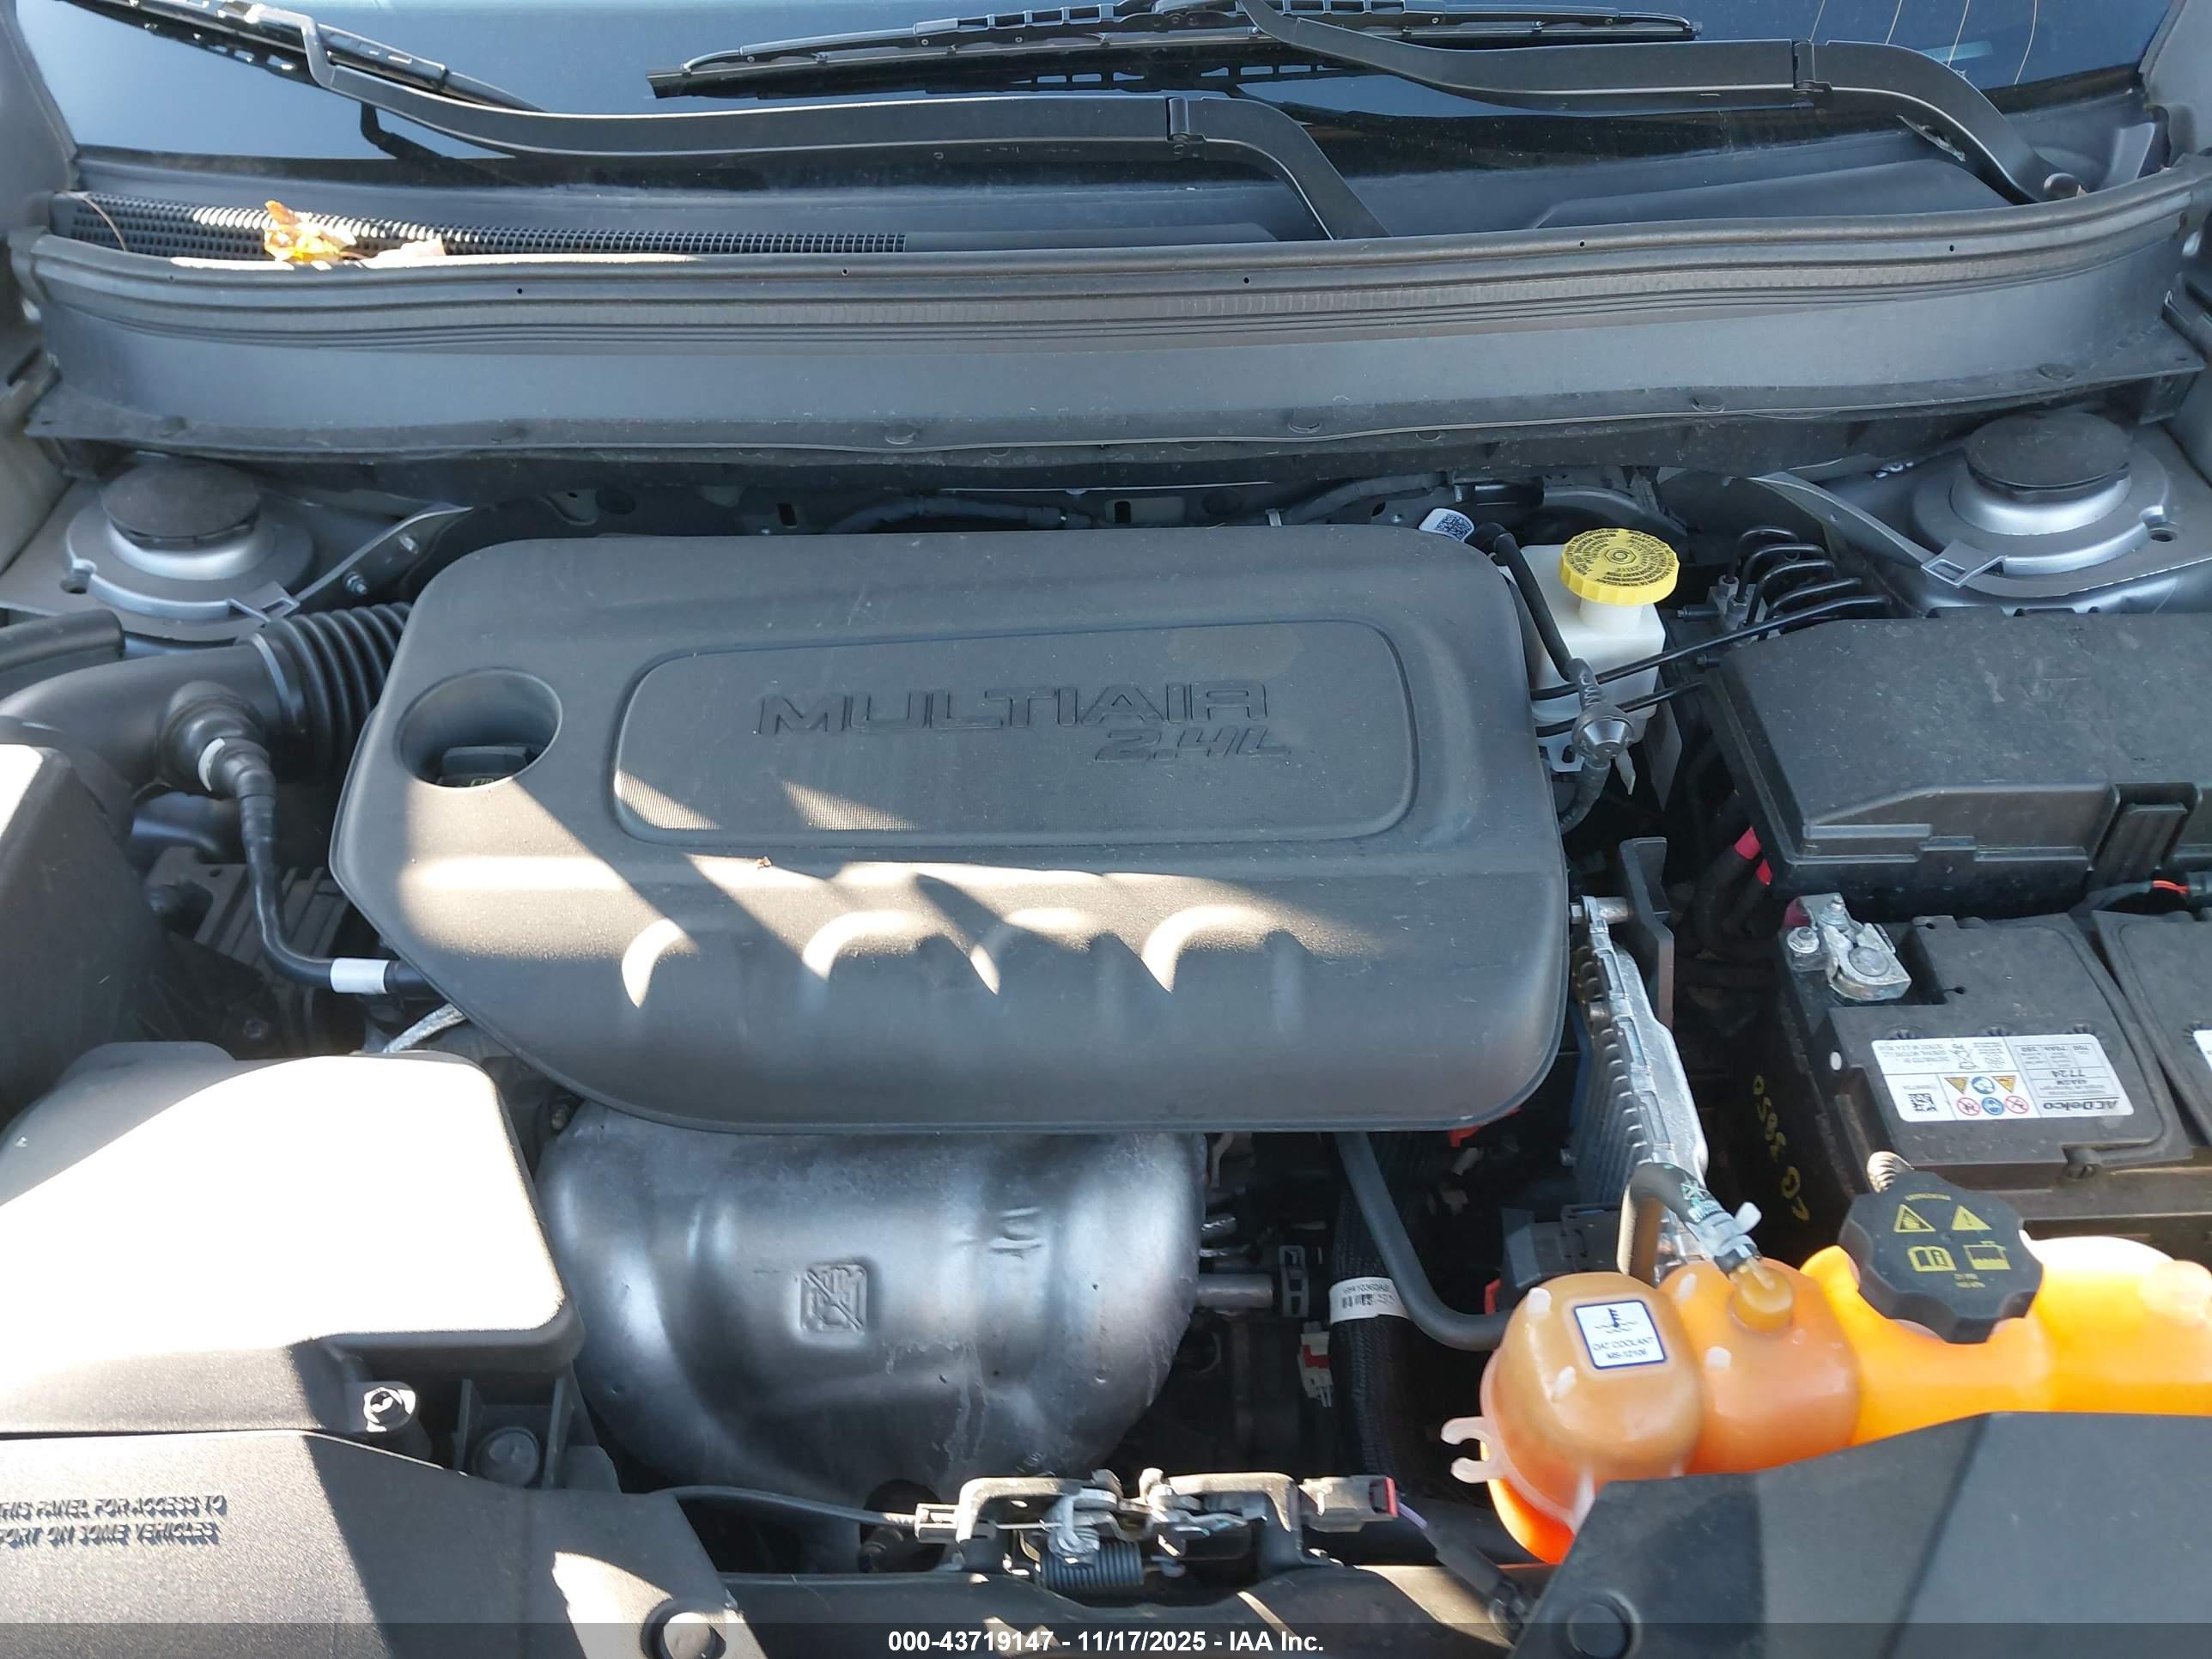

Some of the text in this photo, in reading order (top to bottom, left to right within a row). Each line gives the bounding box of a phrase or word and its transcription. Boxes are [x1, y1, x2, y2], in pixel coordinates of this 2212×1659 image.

[758, 679, 1268, 735] MULTIAIR
[1095, 727, 1291, 763] 2.4L
[2051, 1069, 2087, 1078] 7724
[2042, 1100, 2118, 1111] ACDelco
[37, 1499, 90, 1518] PANEL
[94, 1498, 131, 1517] FOR
[204, 1494, 228, 1515] TO
[47, 1524, 75, 1547] ON
[79, 1523, 131, 1545] SOME
[135, 1522, 220, 1544] VEHICLES
